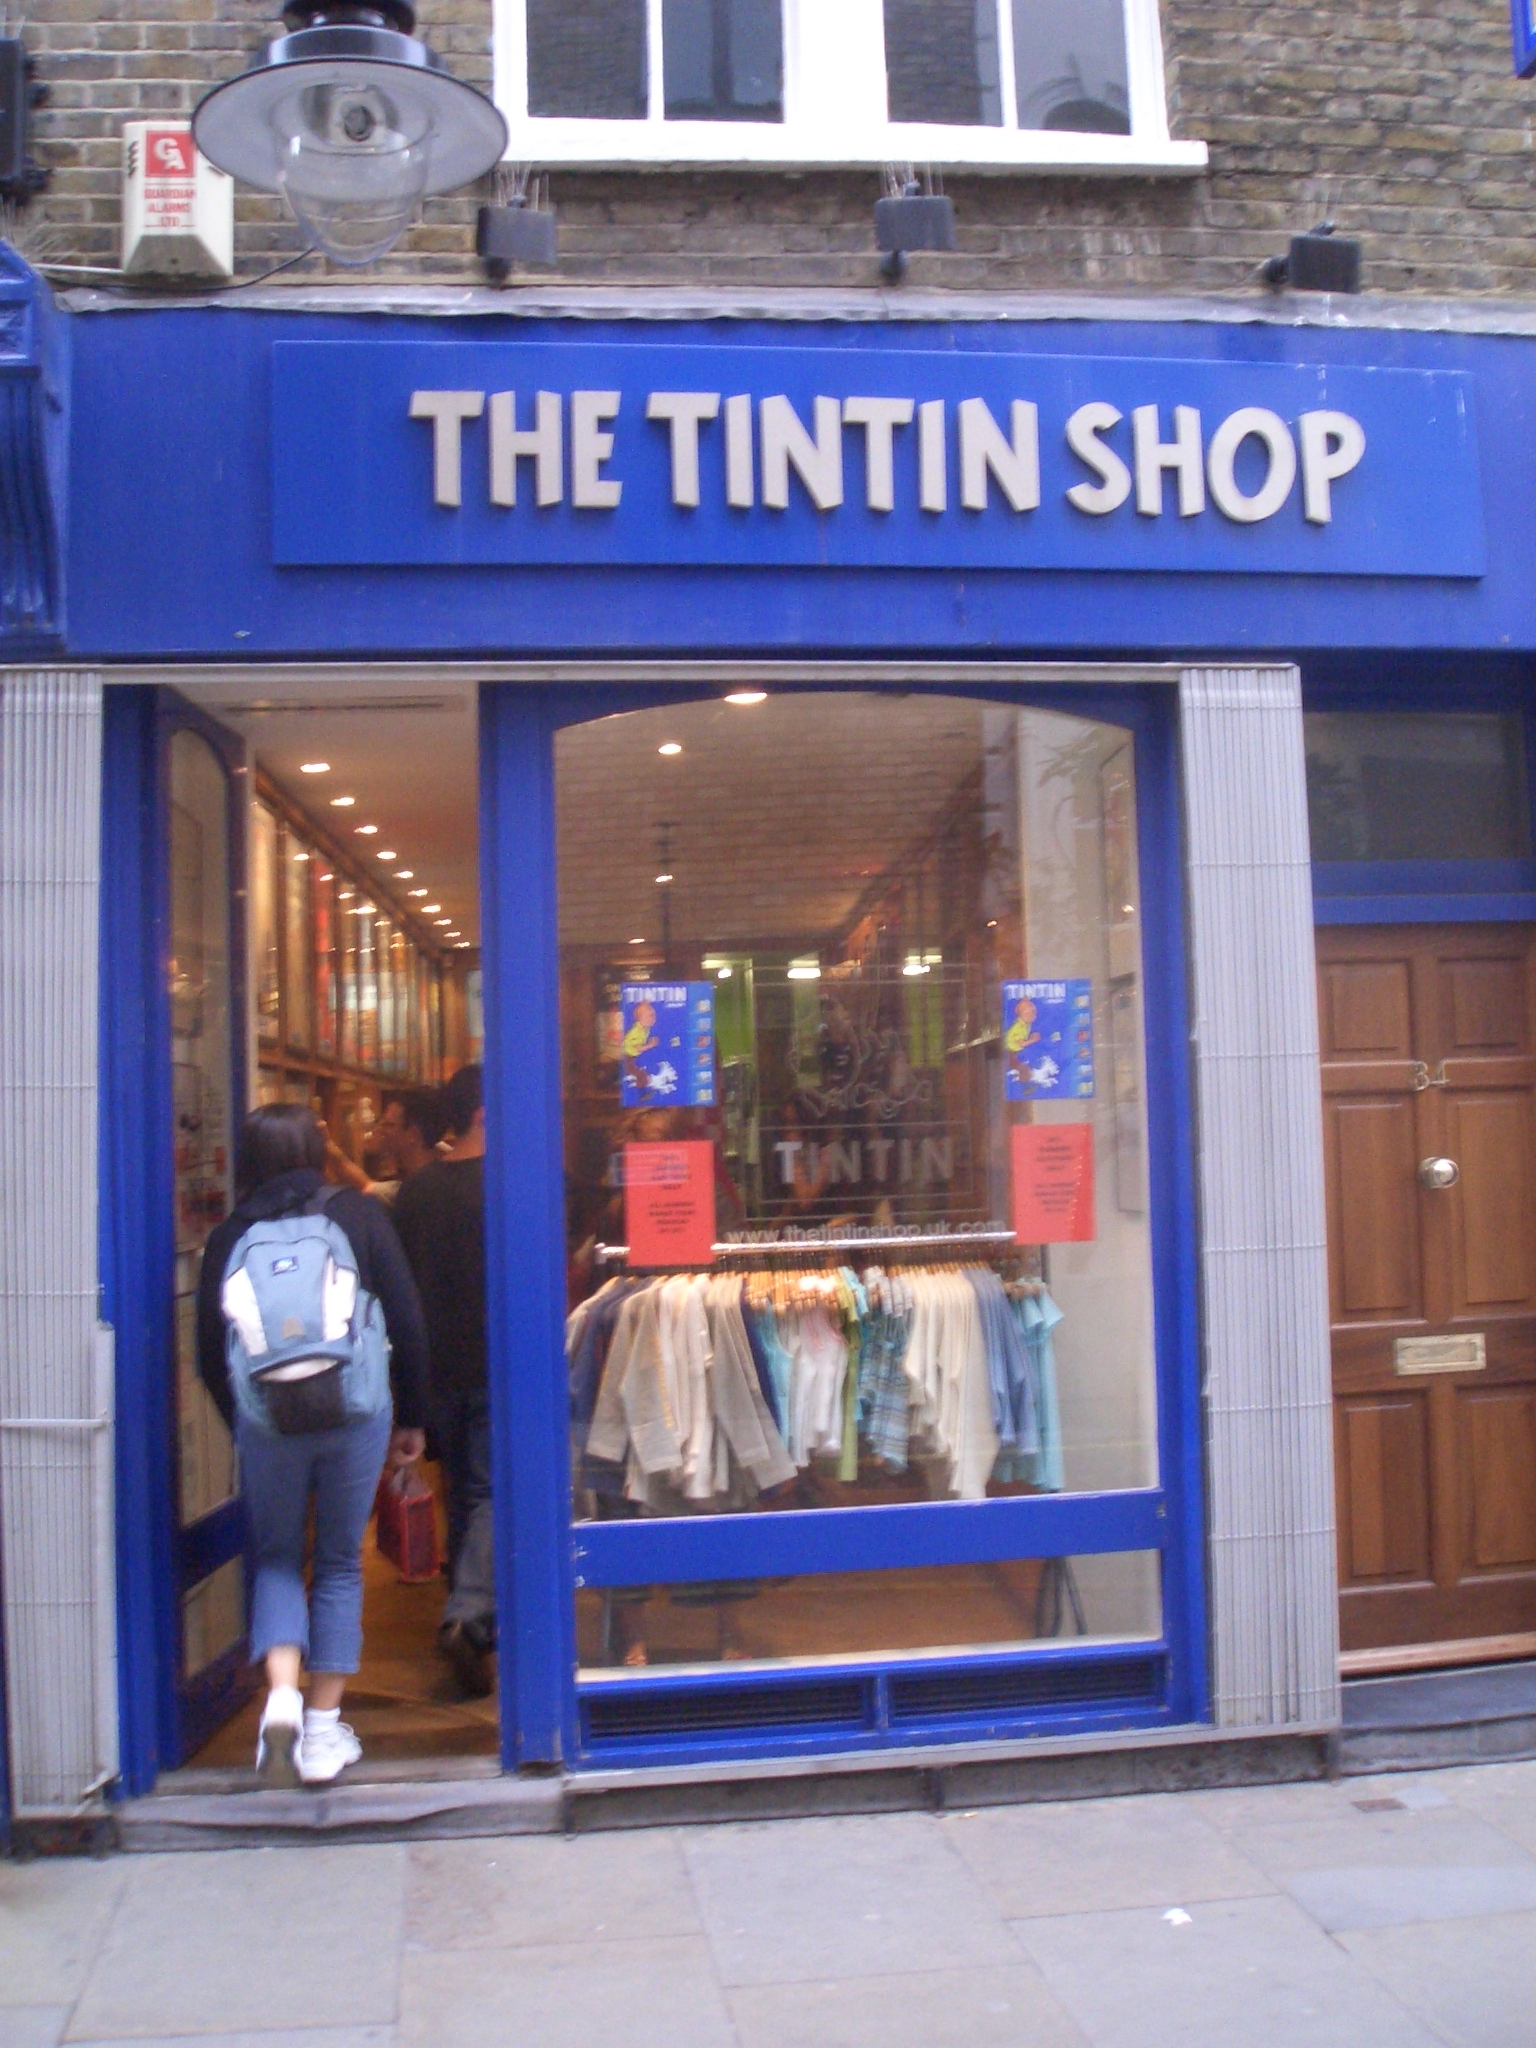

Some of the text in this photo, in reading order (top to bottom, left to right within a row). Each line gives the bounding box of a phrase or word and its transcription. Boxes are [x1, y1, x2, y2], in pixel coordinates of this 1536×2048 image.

[153, 137, 187, 170] GA
[144, 188, 196, 199] GUARDIAN
[147, 203, 191, 213] ALARMS
[408, 389, 1367, 525] THE TINTIN SHOP
[623, 986, 687, 1003] TINTIN
[1003, 983, 1066, 1000] TINTIN
[1410, 1059, 1451, 1091] 34
[772, 1138, 955, 1184] TINTIN
